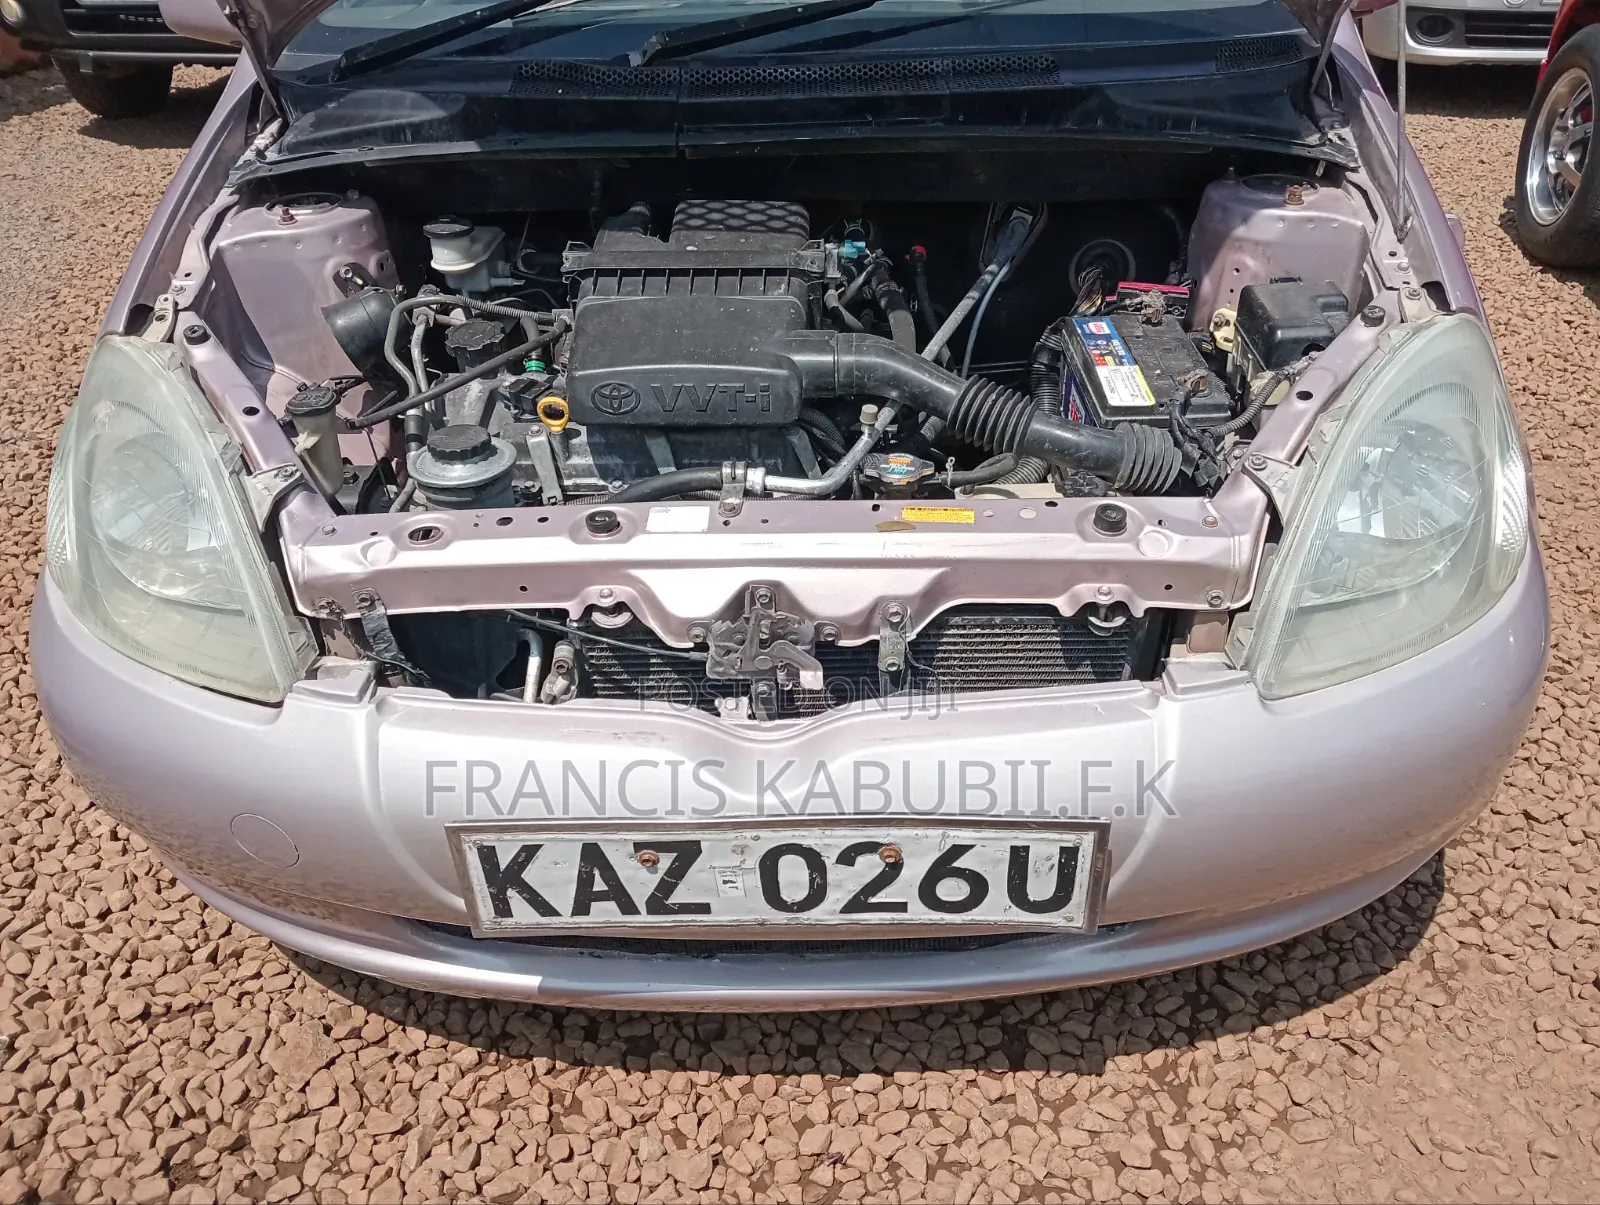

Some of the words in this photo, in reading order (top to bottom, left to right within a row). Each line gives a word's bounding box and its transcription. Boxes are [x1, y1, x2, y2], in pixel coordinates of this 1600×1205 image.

[650, 383, 772, 412] VVT-i
[477, 840, 712, 918] KAZ
[759, 841, 1081, 914] 026U
